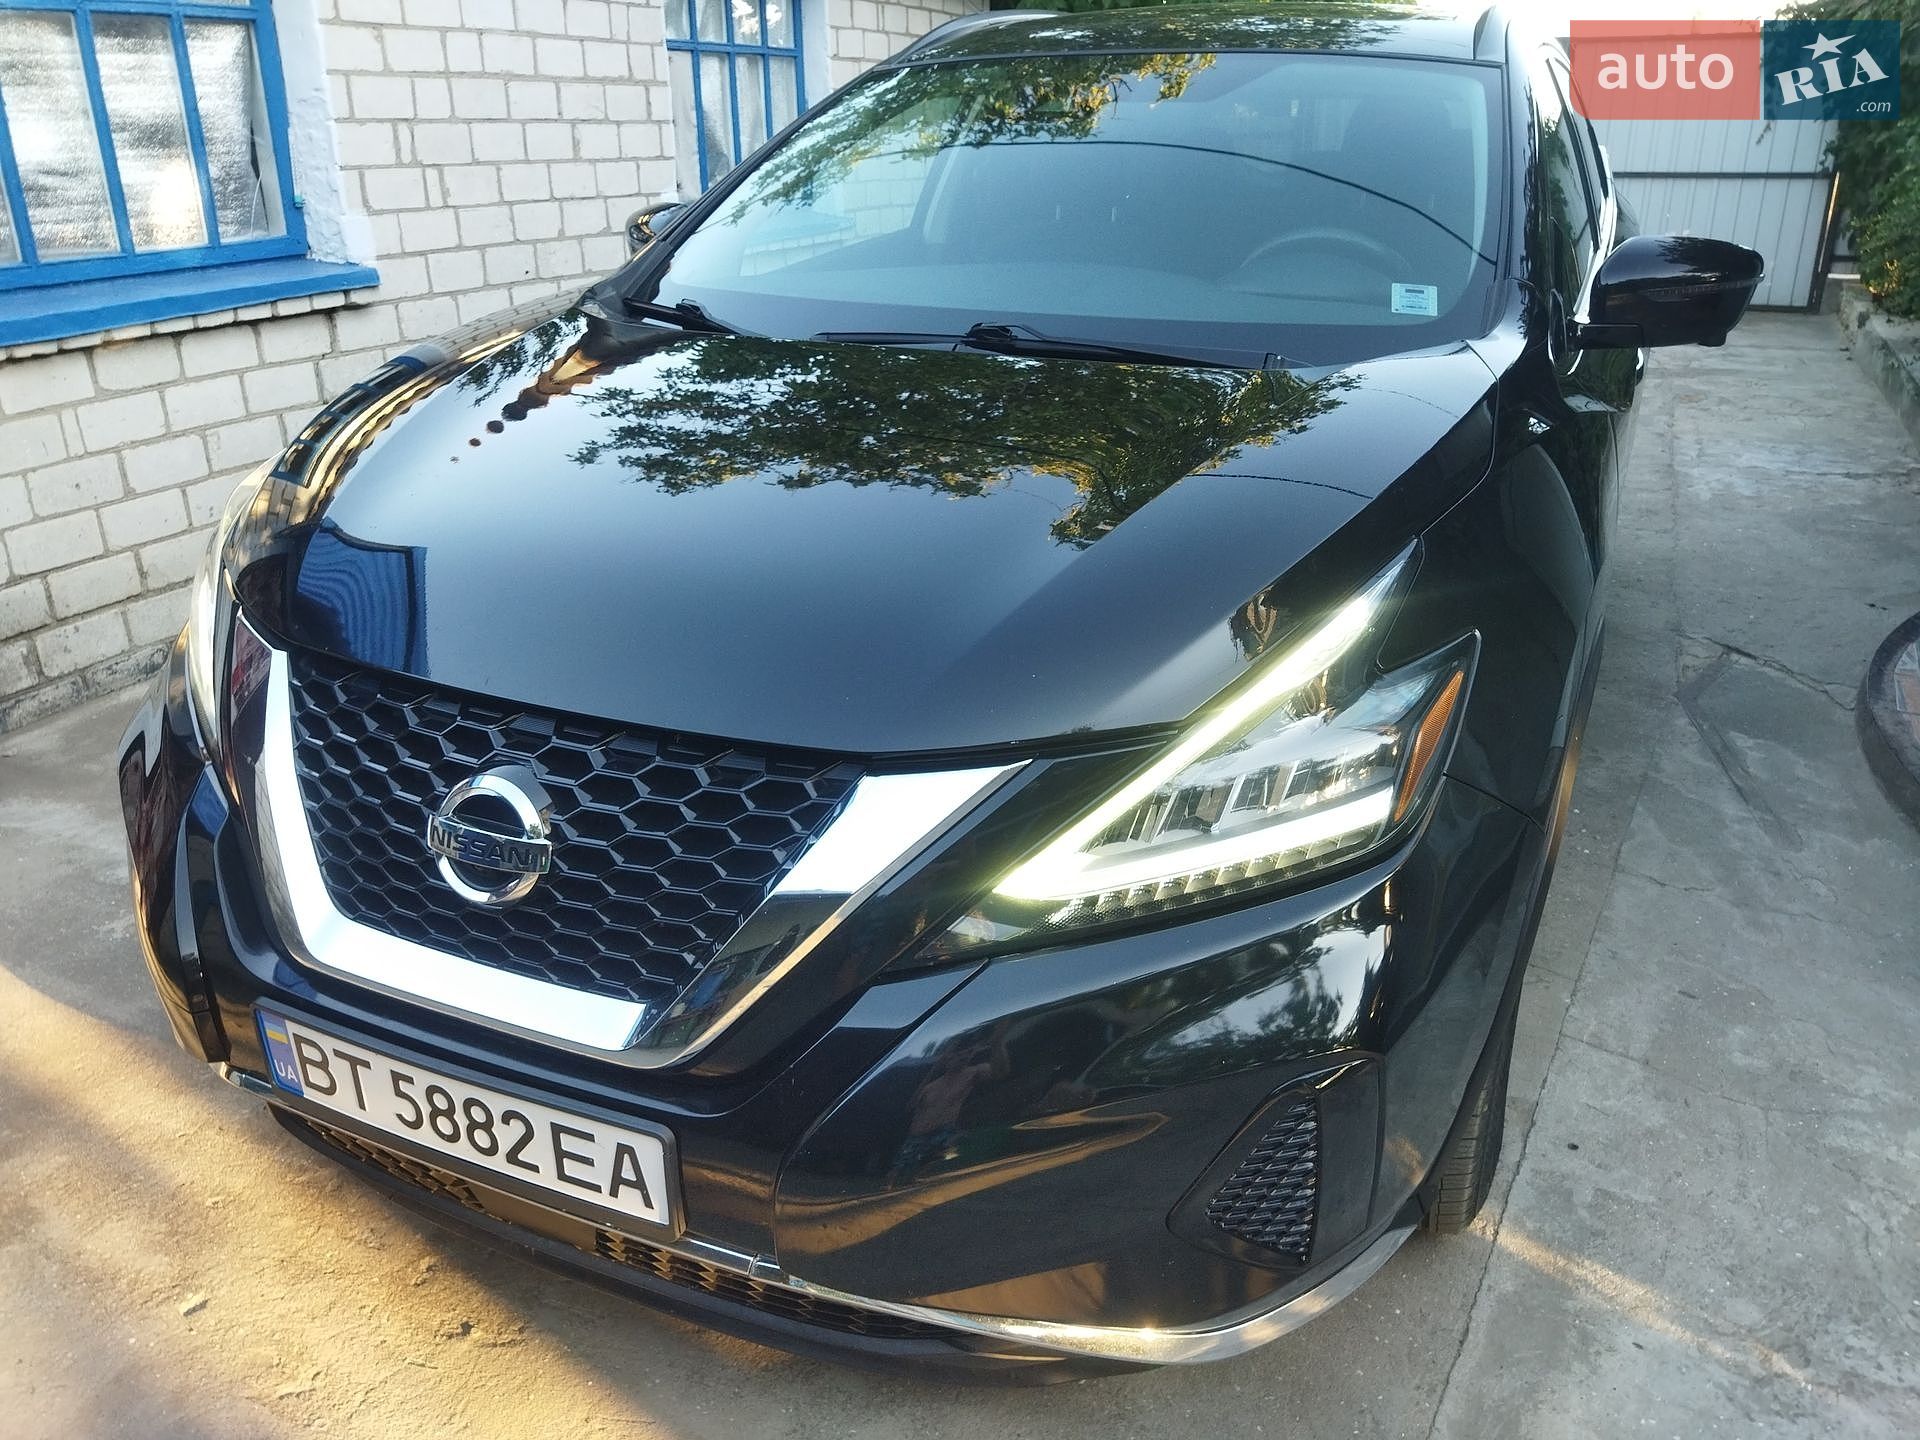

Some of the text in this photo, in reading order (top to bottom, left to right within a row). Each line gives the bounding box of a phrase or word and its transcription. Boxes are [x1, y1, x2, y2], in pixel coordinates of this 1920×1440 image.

[430, 823, 536, 870] NISSAN
[274, 1059, 298, 1083] UA
[292, 1032, 654, 1210] BT 5882 EA
